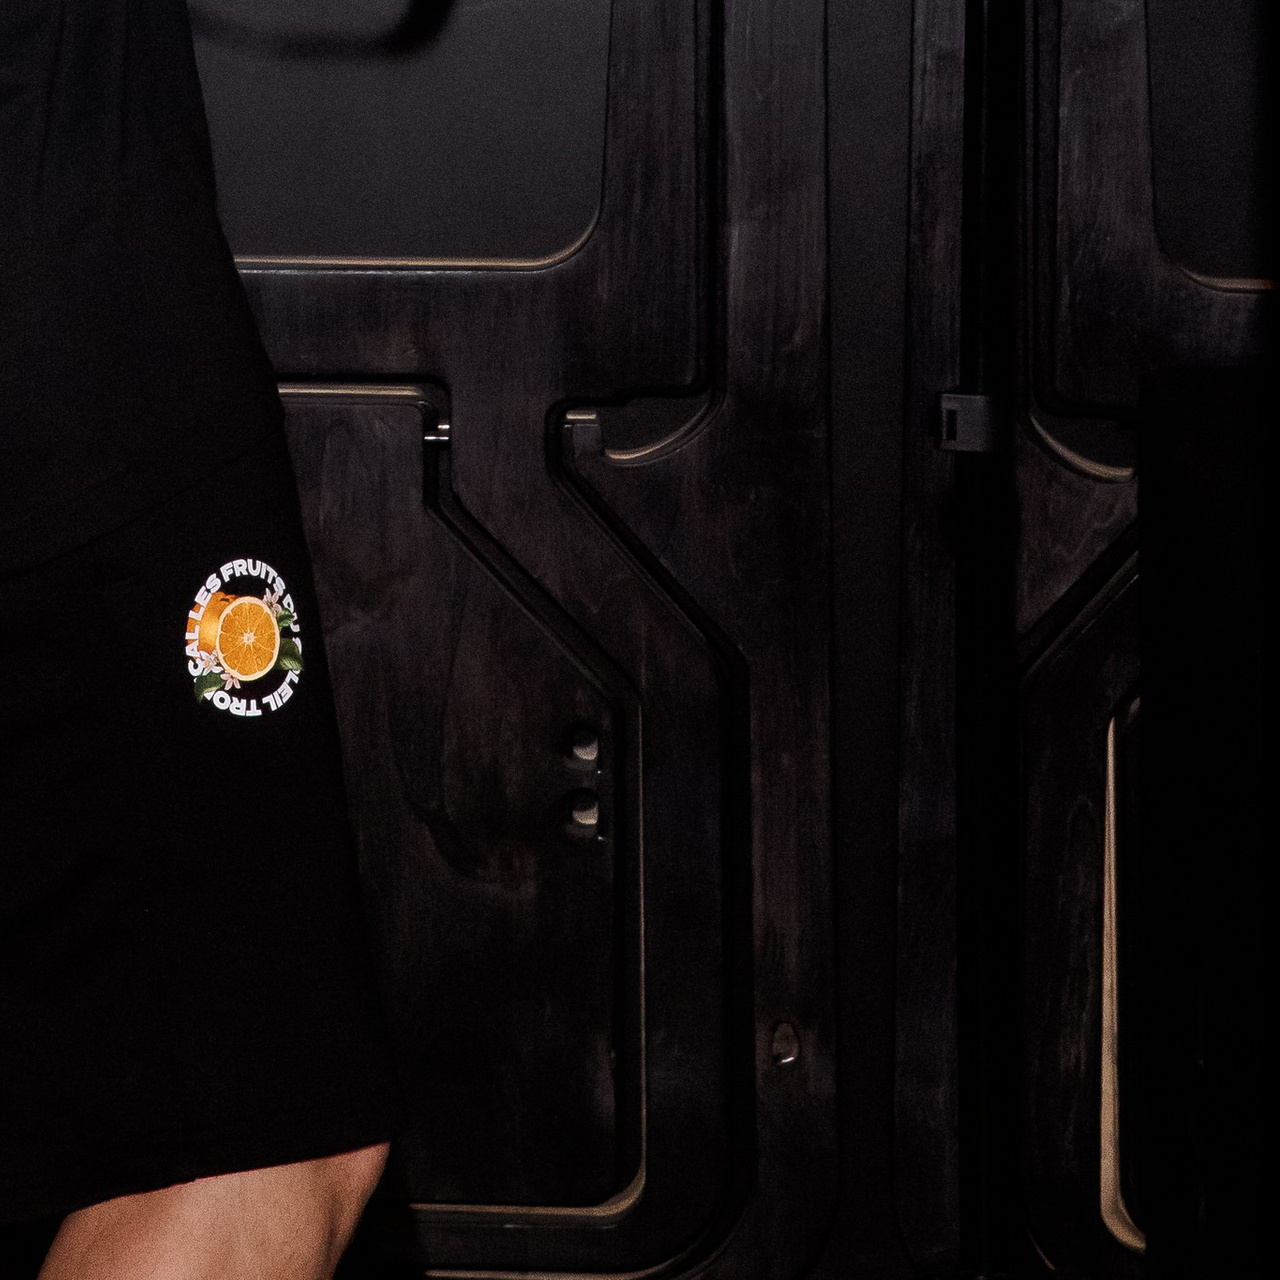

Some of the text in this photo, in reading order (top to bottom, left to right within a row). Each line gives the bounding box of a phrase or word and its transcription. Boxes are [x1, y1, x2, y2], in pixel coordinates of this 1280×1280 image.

[188, 573, 222, 622] LES
[220, 558, 287, 597] FRUITS
[184, 625, 263, 717] TROCAL
[262, 637, 303, 712] LEIL
